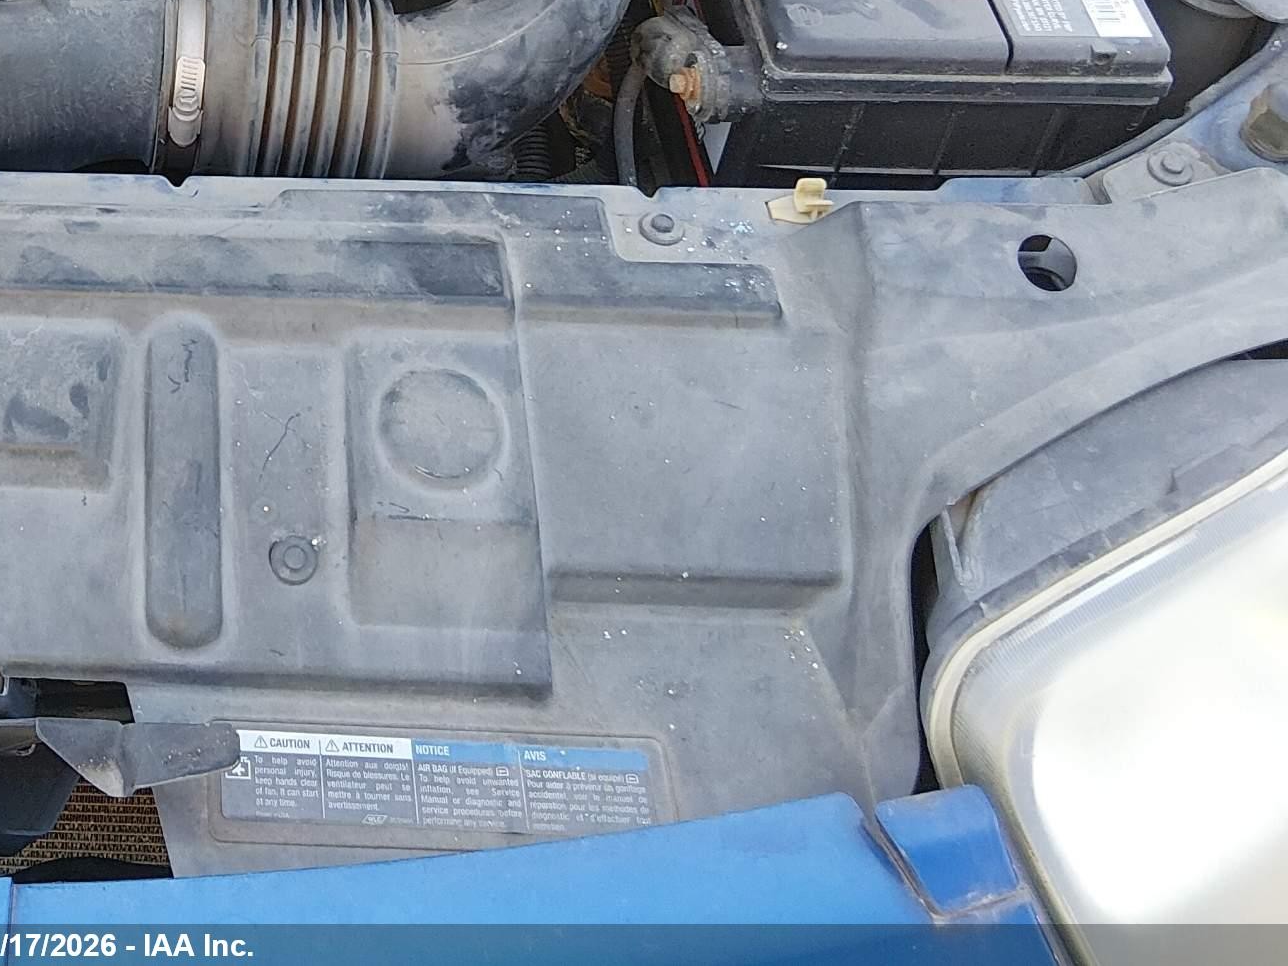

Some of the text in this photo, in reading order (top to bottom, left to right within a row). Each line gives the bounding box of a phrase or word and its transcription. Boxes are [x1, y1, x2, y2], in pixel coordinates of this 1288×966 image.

[270, 738, 310, 748] CAUTION
[342, 742, 393, 753] ATTENTION
[416, 745, 449, 756] NOTICE
[524, 750, 546, 760] AVIS
[272, 757, 288, 765] help
[297, 758, 317, 766] avoid
[326, 759, 359, 768] Attention
[255, 767, 286, 776] personal
[432, 764, 448, 772] BAG
[326, 769, 350, 779] Risque
[526, 769, 541, 778] SAC
[255, 777, 317, 787] keep hands clear
[418, 774, 518, 787] To help avoid unwanted
[327, 781, 410, 792] ventilateur peut se
[328, 791, 352, 799] mettre
[364, 792, 390, 800] tourner
[394, 793, 412, 801] sans
[465, 788, 520, 798] see Service
[265, 799, 278, 808] any
[421, 797, 448, 805] Manual
[465, 798, 502, 808] diagnostic
[507, 799, 522, 808] and
[422, 807, 448, 815] service
